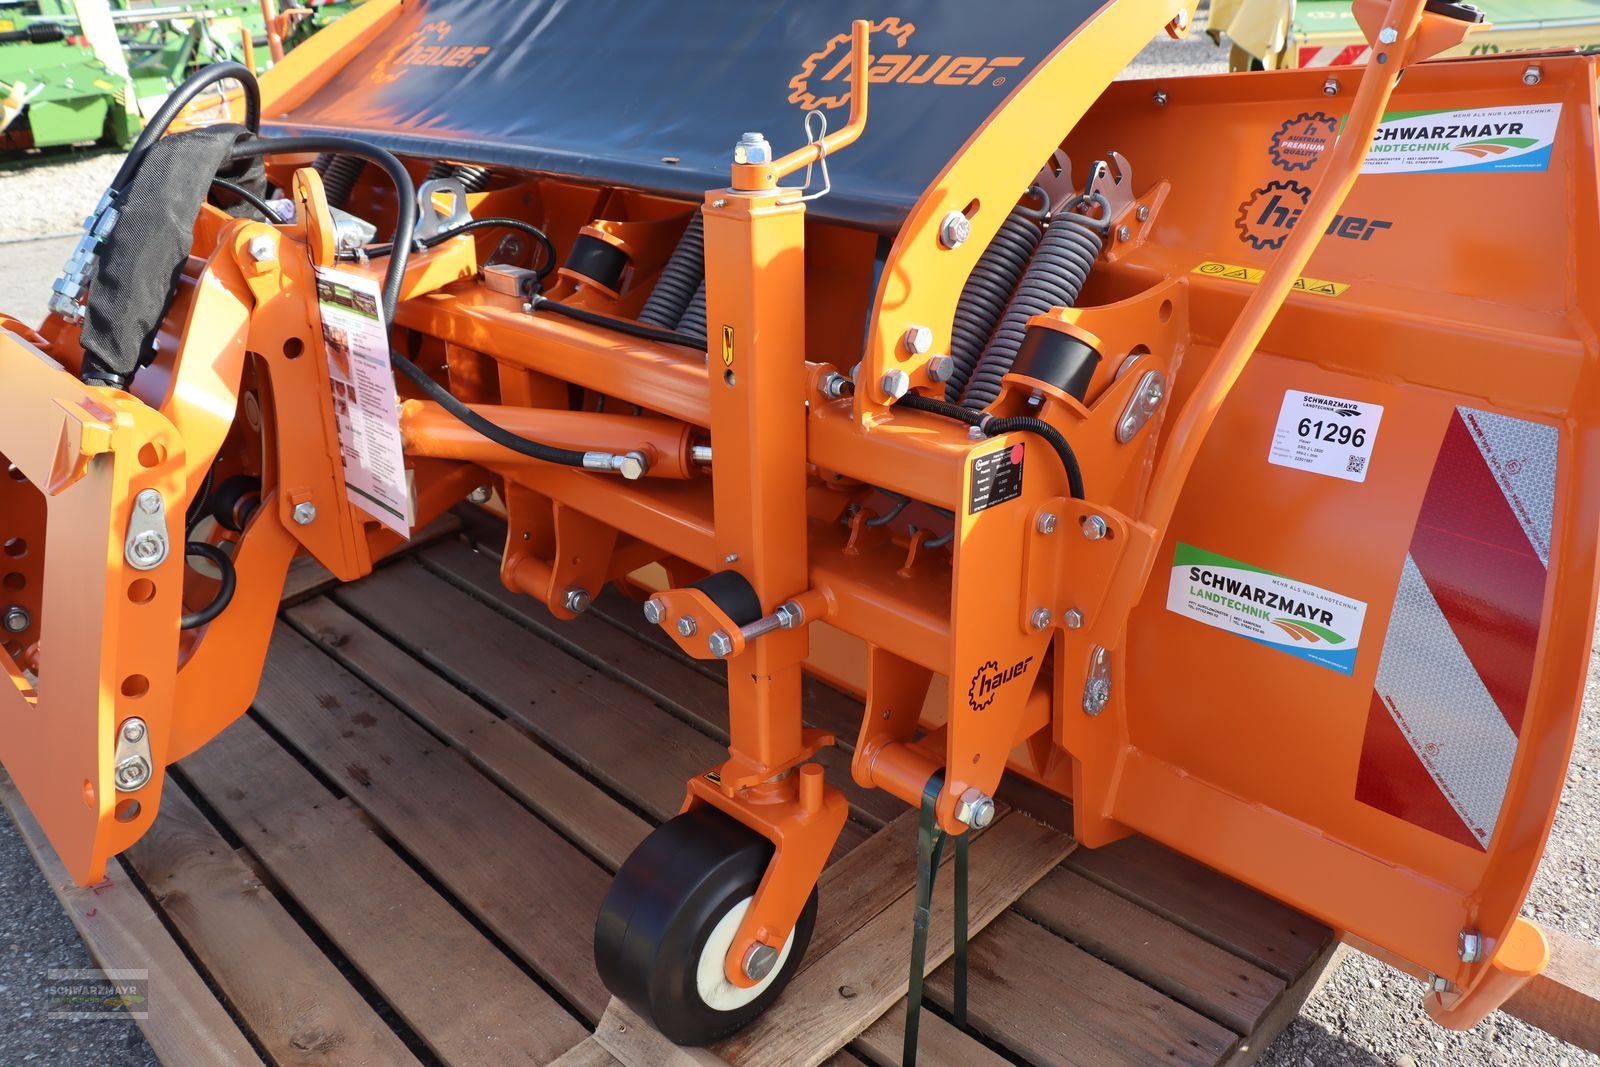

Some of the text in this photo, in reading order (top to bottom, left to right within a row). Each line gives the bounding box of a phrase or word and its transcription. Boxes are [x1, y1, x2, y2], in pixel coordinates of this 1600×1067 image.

[393, 36, 491, 67] hauer
[1374, 123, 1523, 141] CHWARZMAYR
[1281, 141, 1325, 152] PREMIUM
[1303, 396, 1358, 410] SCHWARZMAYR
[1303, 403, 1334, 411] LANDTECHNIK
[1298, 418, 1366, 447] 61296
[1272, 580, 1288, 588] MEHR
[1189, 567, 1333, 627] SCHWARZMAYR
[1190, 586, 1271, 621] LANDTECHNIK
[979, 656, 1033, 697] hauer
